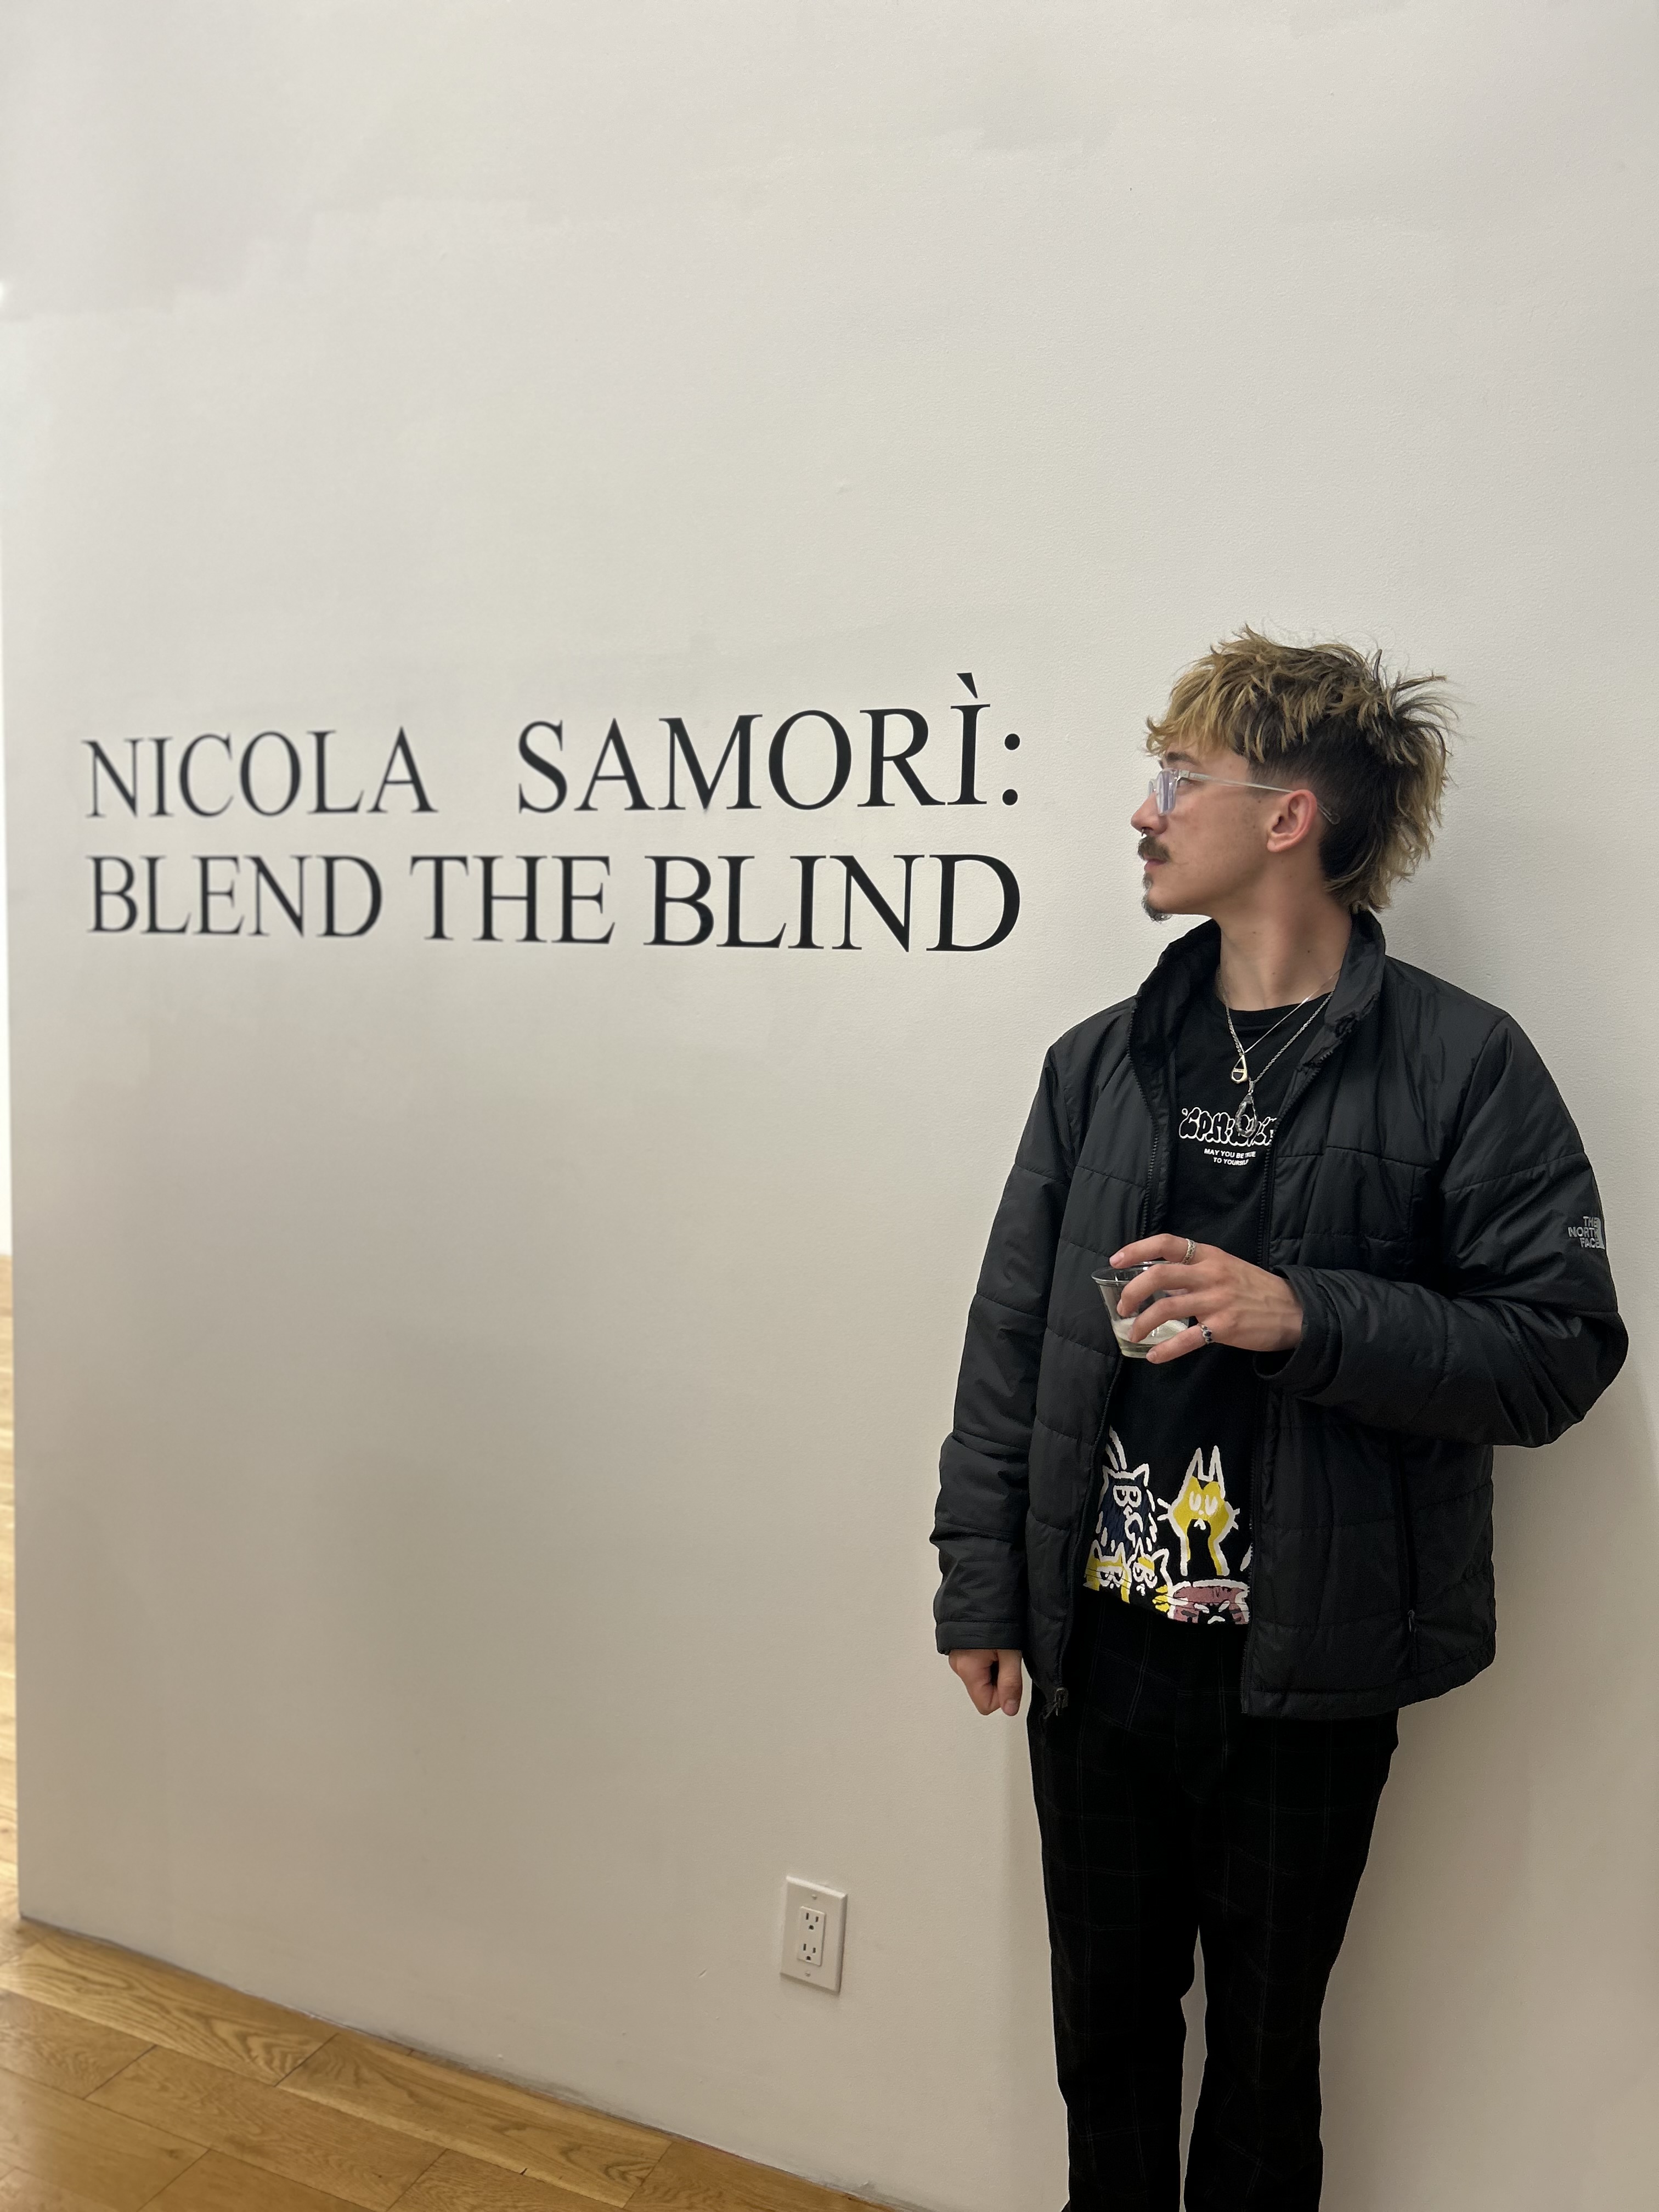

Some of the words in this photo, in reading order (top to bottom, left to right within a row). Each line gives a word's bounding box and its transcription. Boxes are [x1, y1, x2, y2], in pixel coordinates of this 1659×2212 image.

[82, 726, 438, 817] NICOLA
[518, 673, 1020, 814] SAMORÌ:
[86, 856, 382, 937] BLEND
[409, 856, 615, 945] THE
[644, 854, 1020, 952] BLIND
[1583, 1216, 1599, 1227] THE
